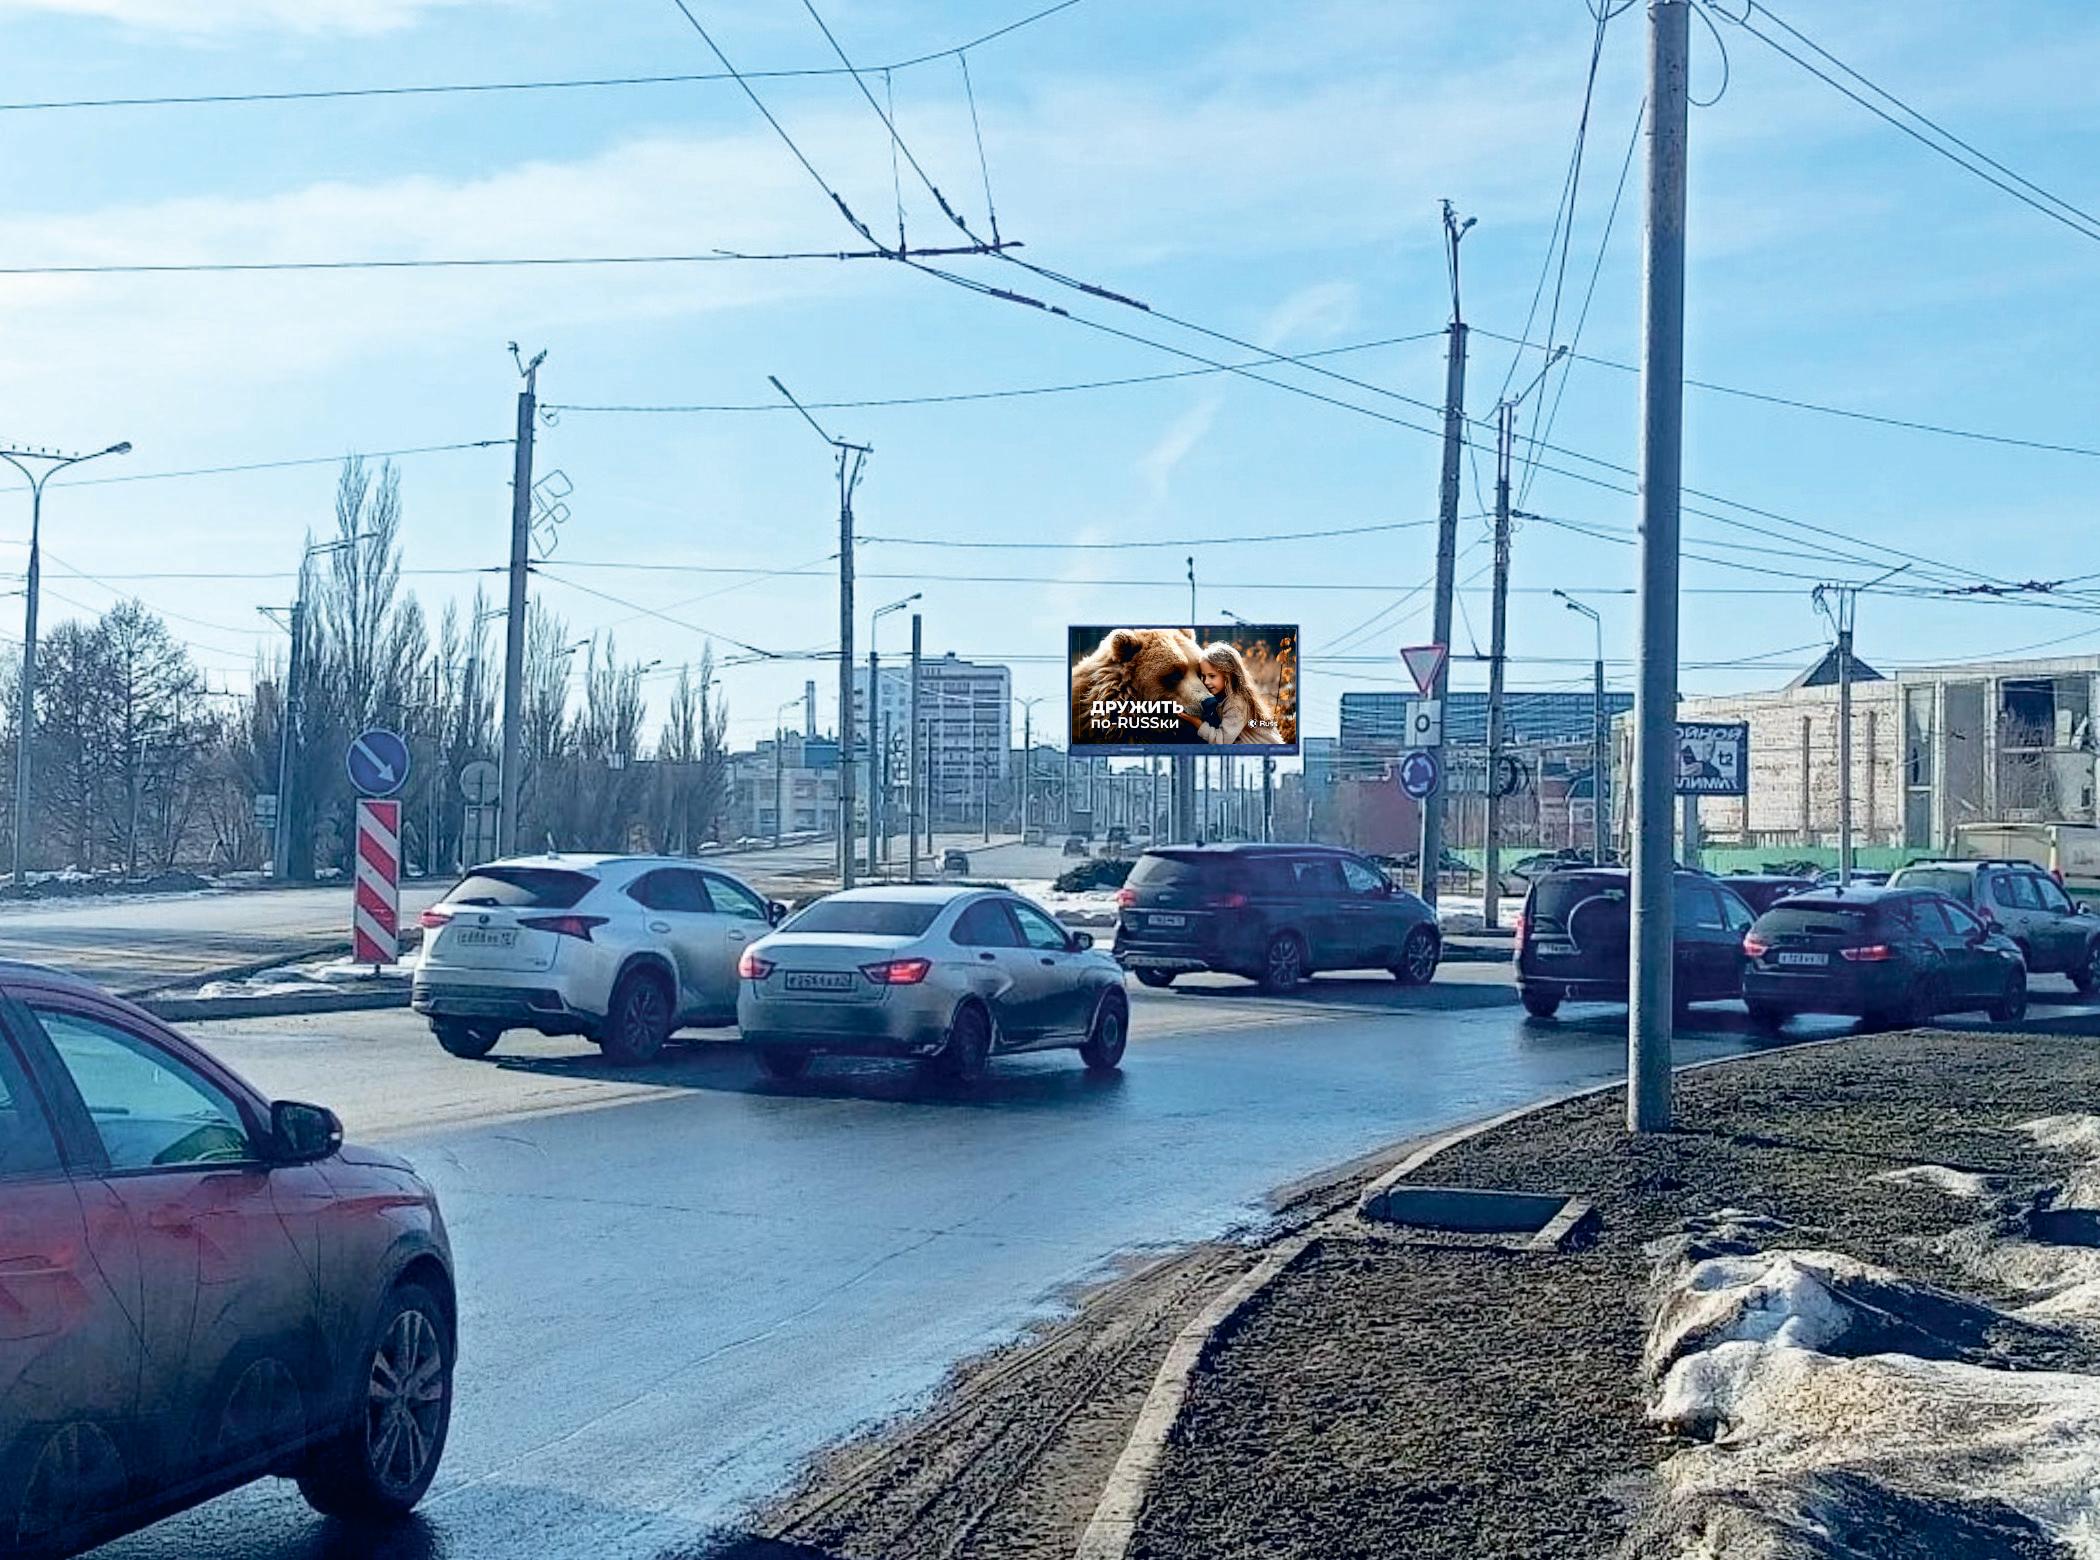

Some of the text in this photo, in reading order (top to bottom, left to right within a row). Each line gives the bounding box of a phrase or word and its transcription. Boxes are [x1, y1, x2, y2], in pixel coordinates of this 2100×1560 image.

[1090, 700, 1184, 715] ДРУЖИТЬ
[1090, 716, 1180, 729] по-RUSSки
[1673, 726, 1743, 740] ОЙНОЙ
[1718, 750, 1734, 766] t2
